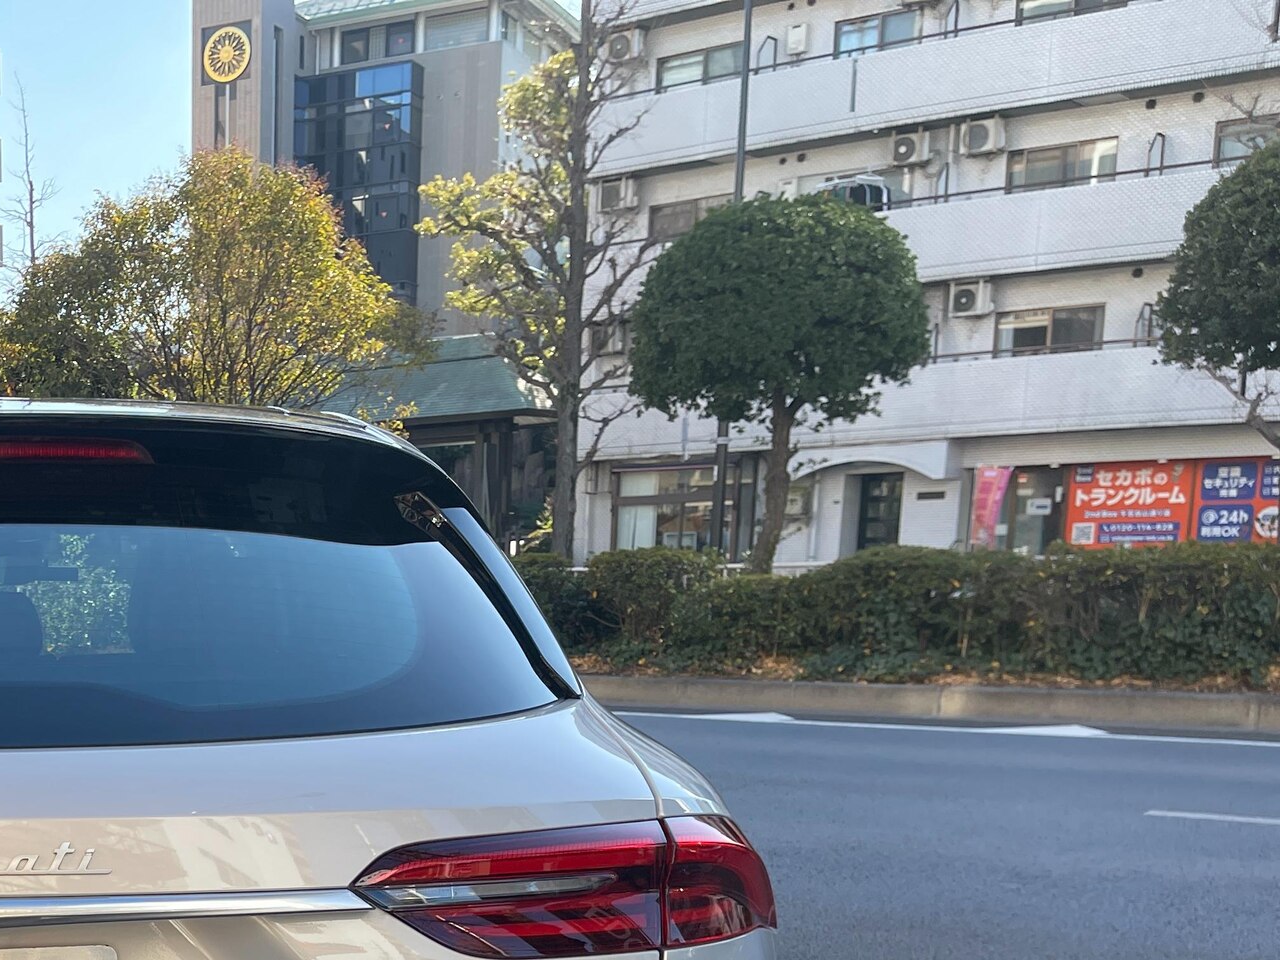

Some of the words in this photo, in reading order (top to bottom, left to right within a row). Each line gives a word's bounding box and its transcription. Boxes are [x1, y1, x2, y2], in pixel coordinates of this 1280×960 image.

[1096, 467, 1168, 487] セカボの
[1075, 486, 1186, 507] トランクルーム
[1219, 509, 1249, 525] 24h
